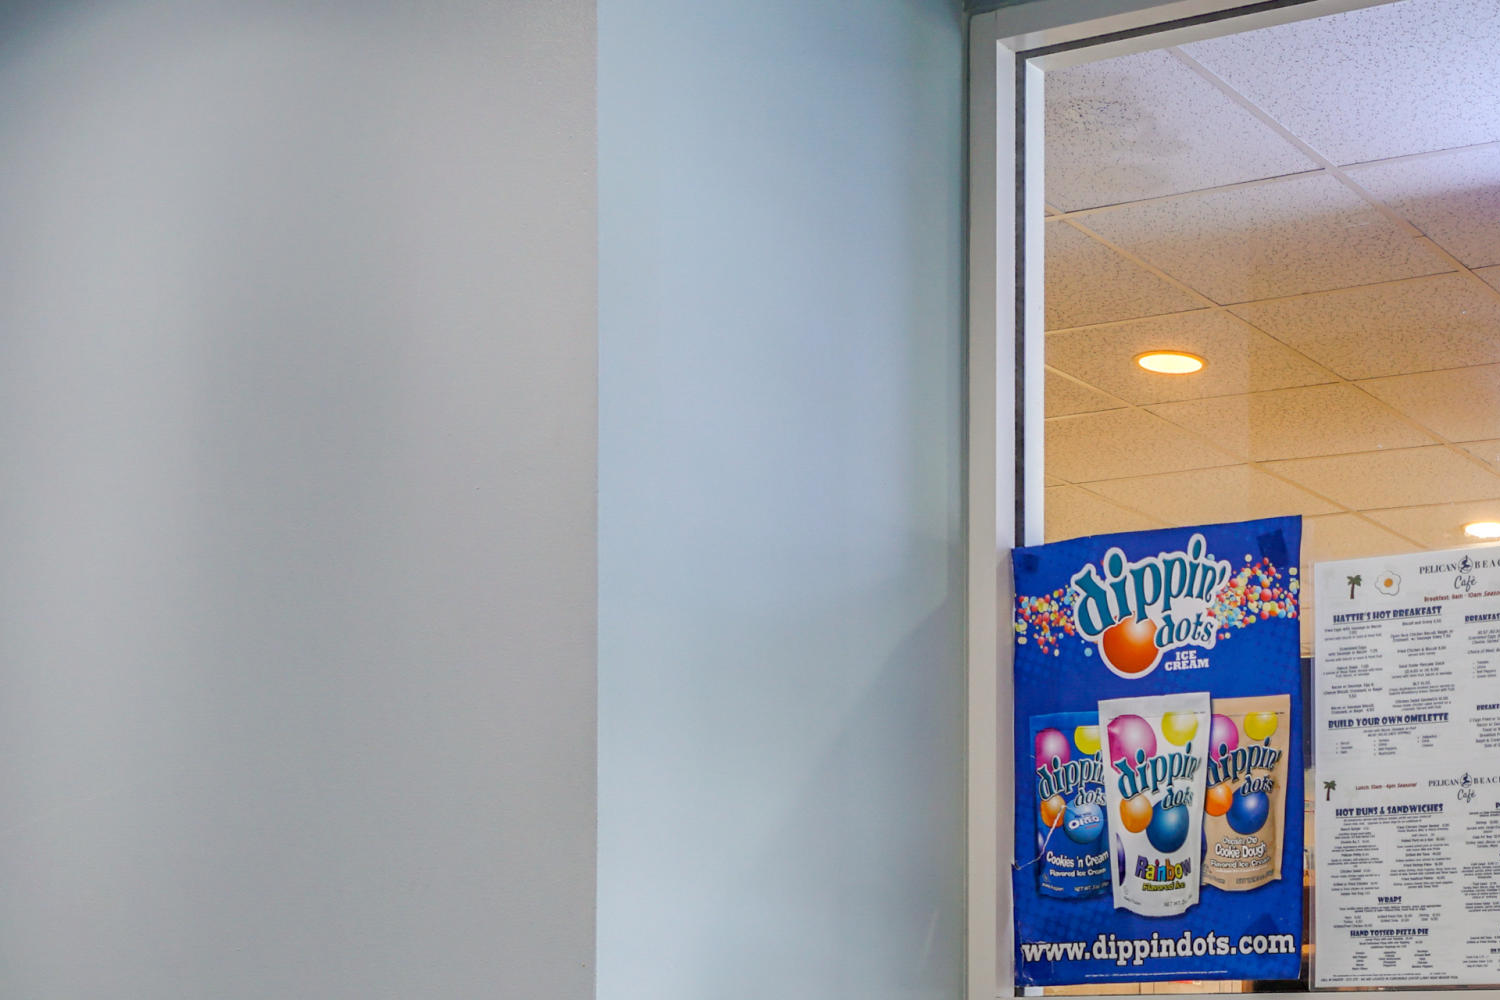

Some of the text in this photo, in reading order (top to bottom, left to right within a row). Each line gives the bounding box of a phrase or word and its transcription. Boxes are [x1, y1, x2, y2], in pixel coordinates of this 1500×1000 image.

[1419, 563, 1458, 574] PELICAN
[1074, 538, 1227, 637] dippin'
[1373, 610, 1391, 619] HOT
[1392, 606, 1442, 618] BREAKFAST
[1155, 612, 1214, 648] dots
[1175, 650, 1197, 662] ICE
[1164, 657, 1210, 672] CREAM
[1328, 712, 1449, 729] BUILD YOUR OWN OMELETTE
[1240, 773, 1274, 798] dots
[1074, 786, 1106, 808] dots
[1162, 786, 1194, 810] dots
[1336, 803, 1444, 817] HOT BUNS & SANDWICHES
[1068, 815, 1100, 830] OREO
[1215, 842, 1266, 859] Cookie Dough
[1046, 851, 1075, 869] Cookies
[1085, 851, 1109, 866] Cream
[1210, 857, 1271, 869] Flavored Ice Cream
[1049, 868, 1106, 878] Flavored Ice Cream
[1135, 855, 1191, 882] Rainbow
[1142, 881, 1186, 892] Flavored Ice
[1377, 896, 1402, 904] WRAPS
[1370, 929, 1394, 937] TOSSED
[1396, 928, 1416, 936] PIZZA
[1021, 931, 1296, 966] www.dippindots.com
